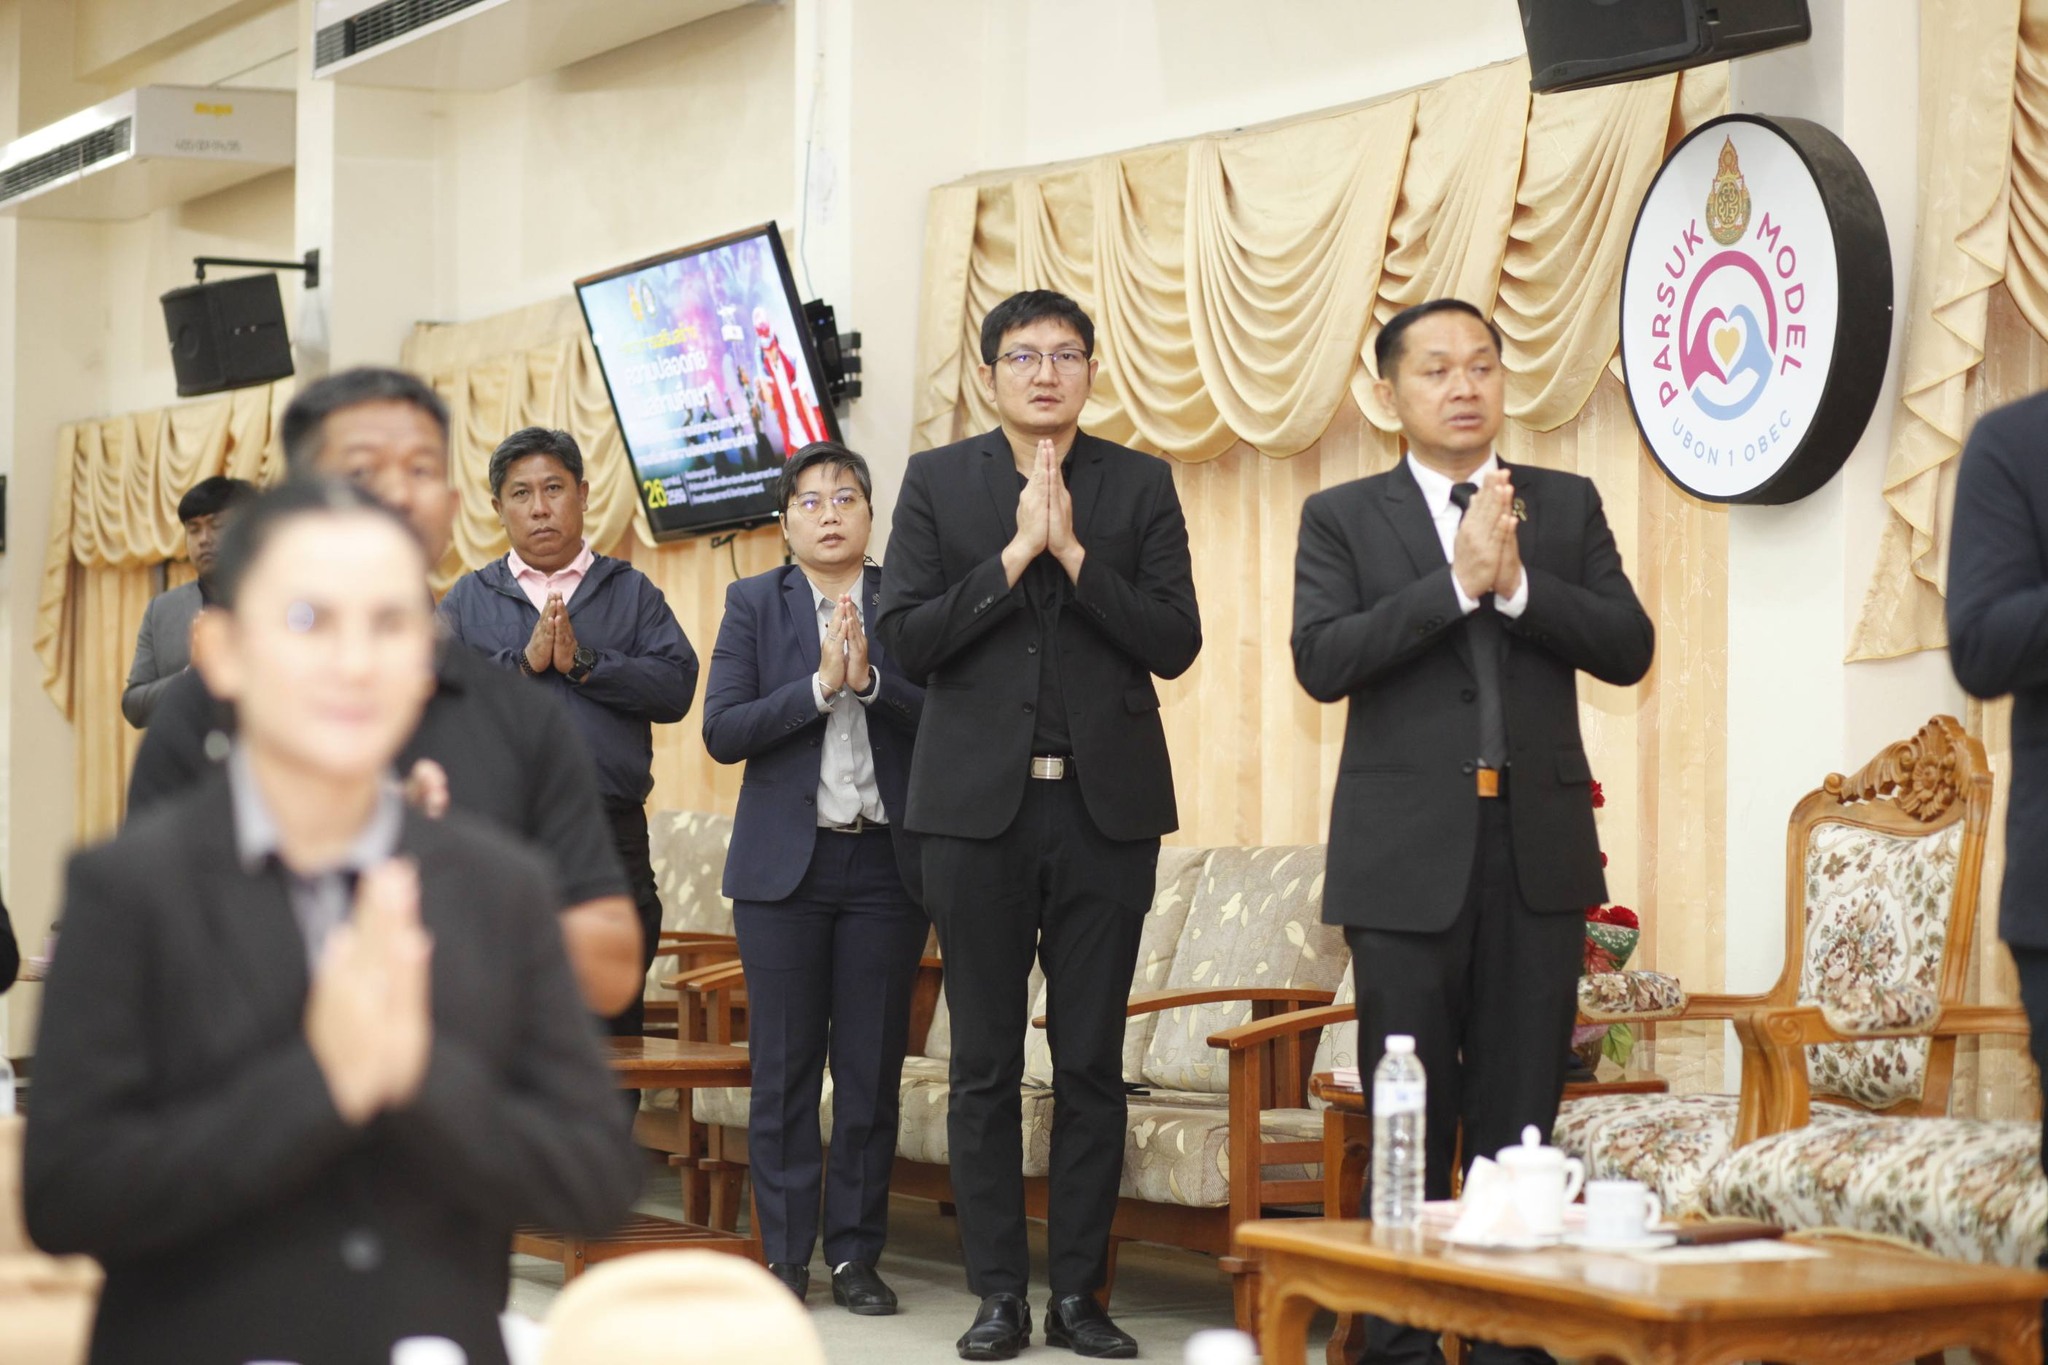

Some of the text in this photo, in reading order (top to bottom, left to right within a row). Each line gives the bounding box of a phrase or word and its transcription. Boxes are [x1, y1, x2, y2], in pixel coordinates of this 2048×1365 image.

[1651, 211, 1806, 408] PARSUK MODEL
[1672, 409, 1792, 467] UBON 1 OBEC
[643, 478, 668, 508] 26
